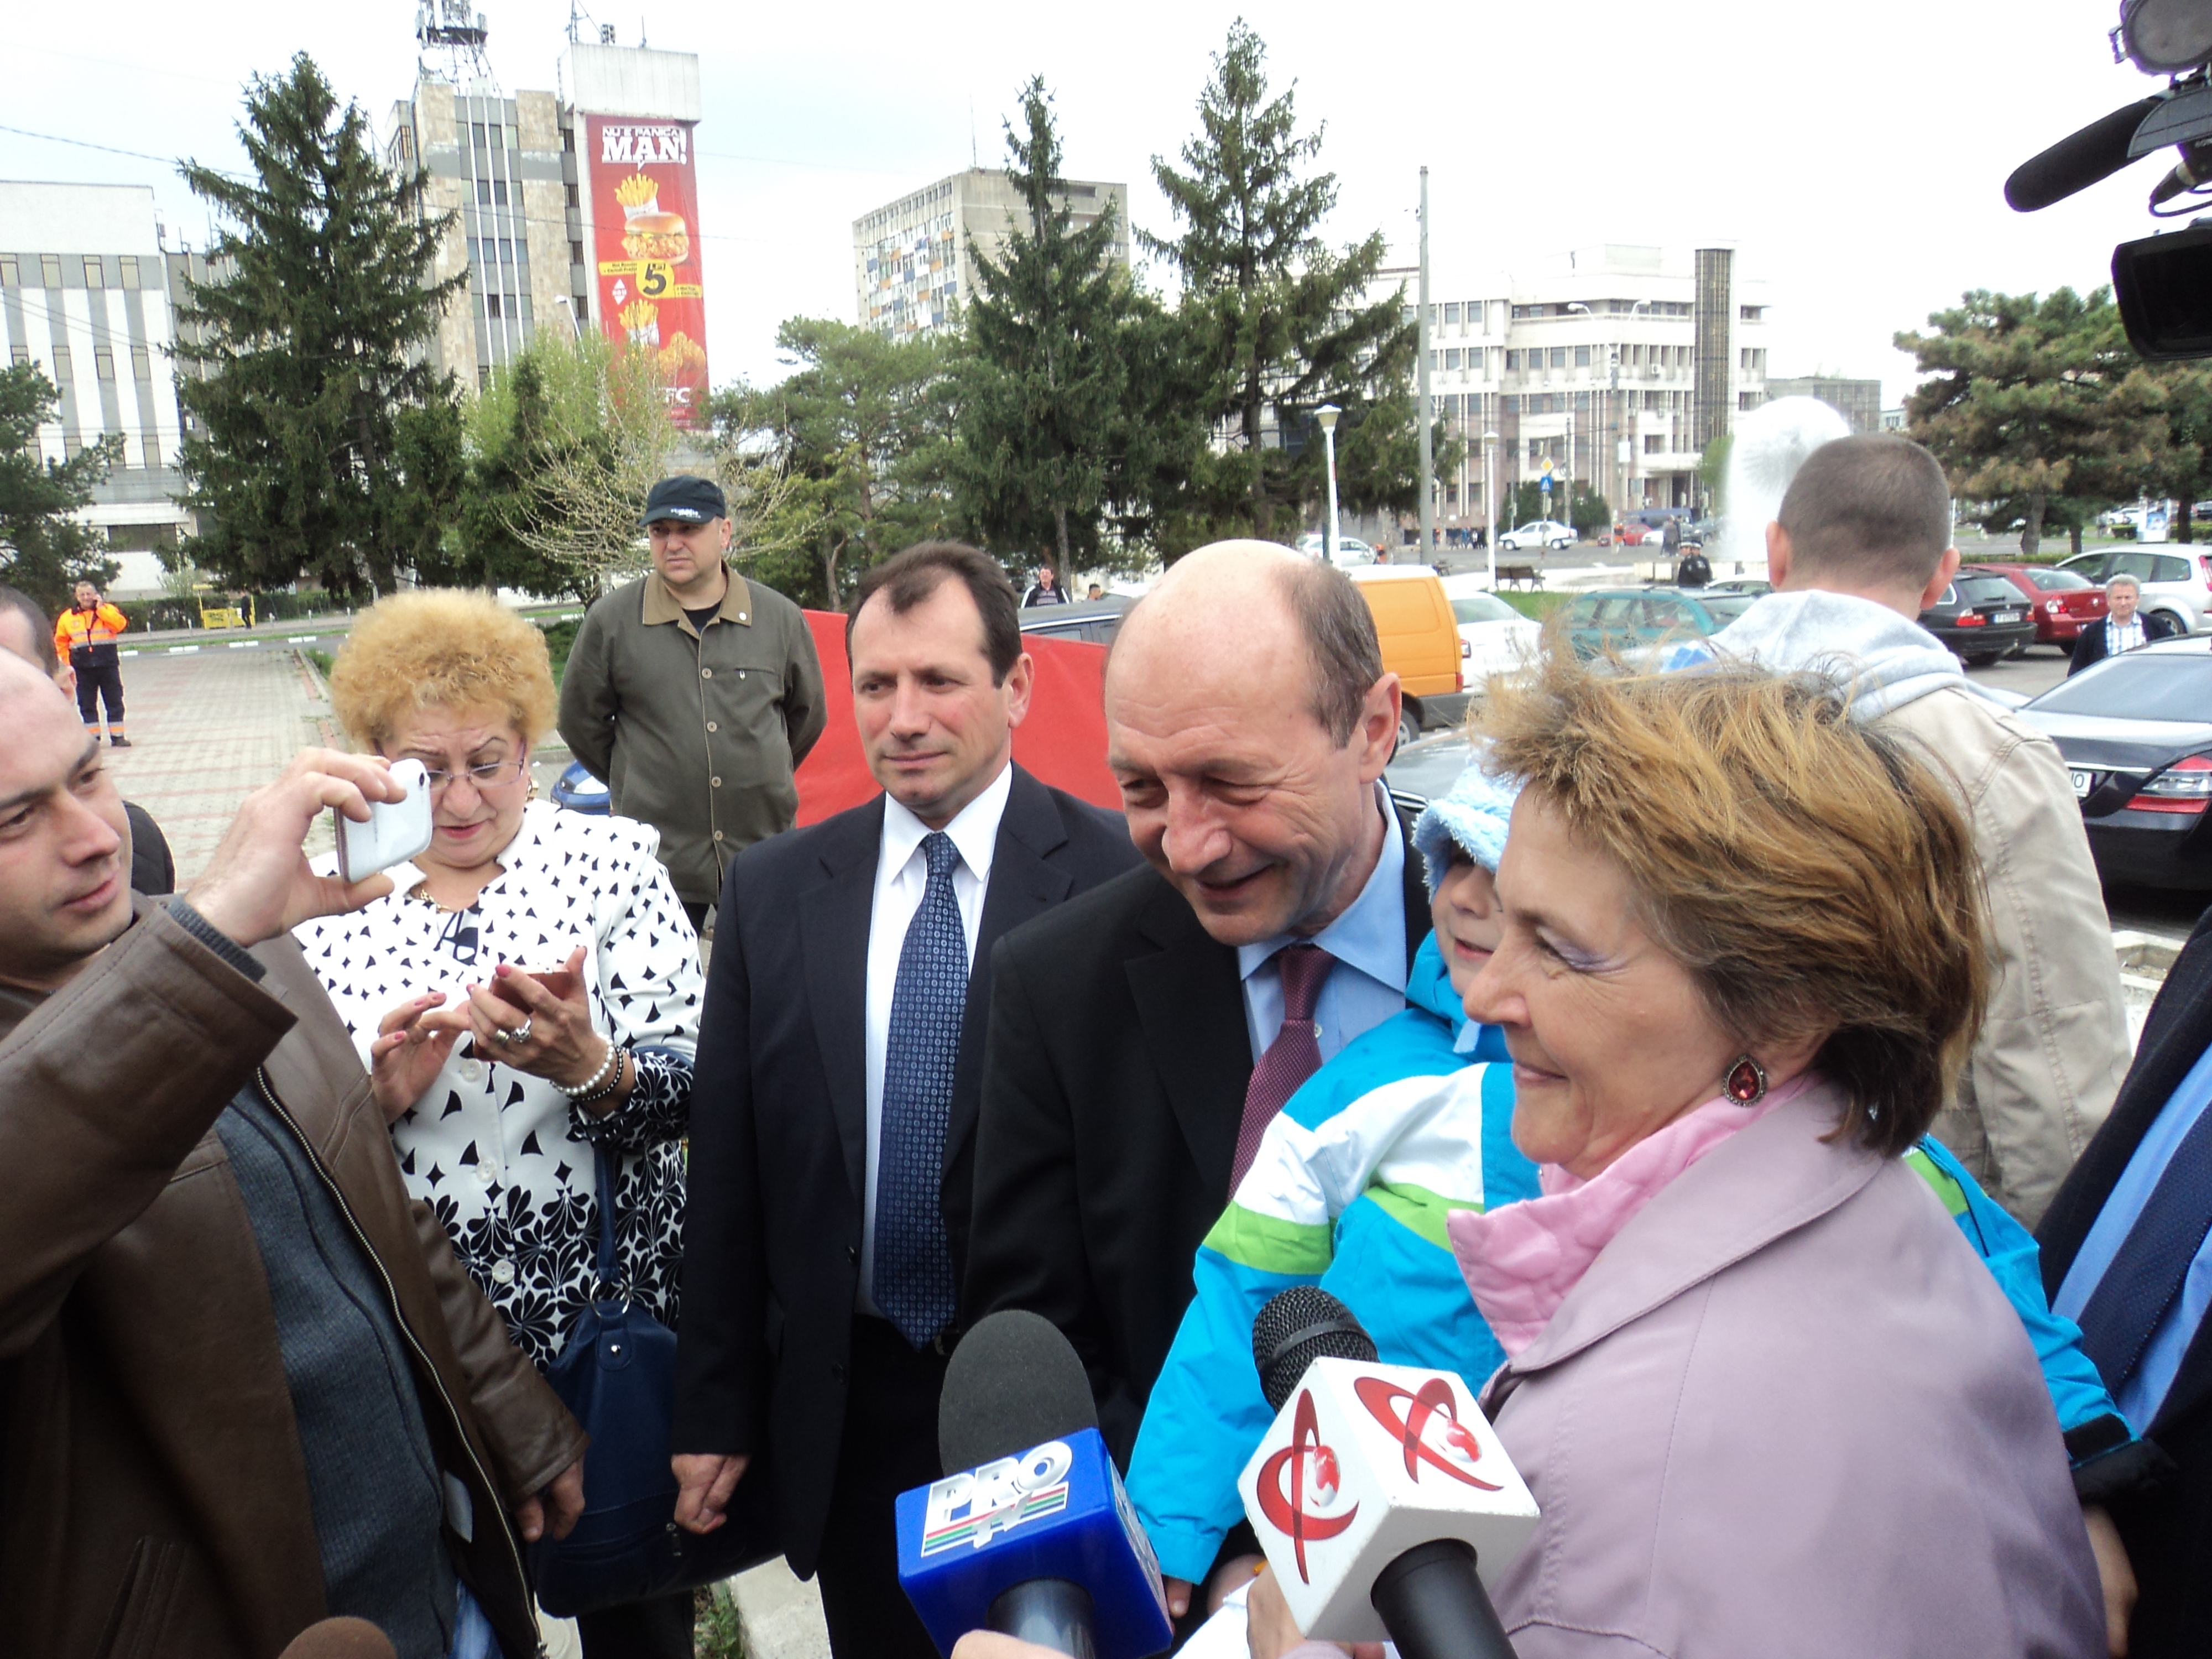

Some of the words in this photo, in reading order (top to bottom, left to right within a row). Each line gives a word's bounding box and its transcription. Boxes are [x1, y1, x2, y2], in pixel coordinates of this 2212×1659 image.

[602, 128, 687, 165] MAN!
[603, 127, 620, 137] NU
[624, 127, 632, 137] E
[643, 263, 667, 295] 5
[926, 1441, 1072, 1530] PRO
